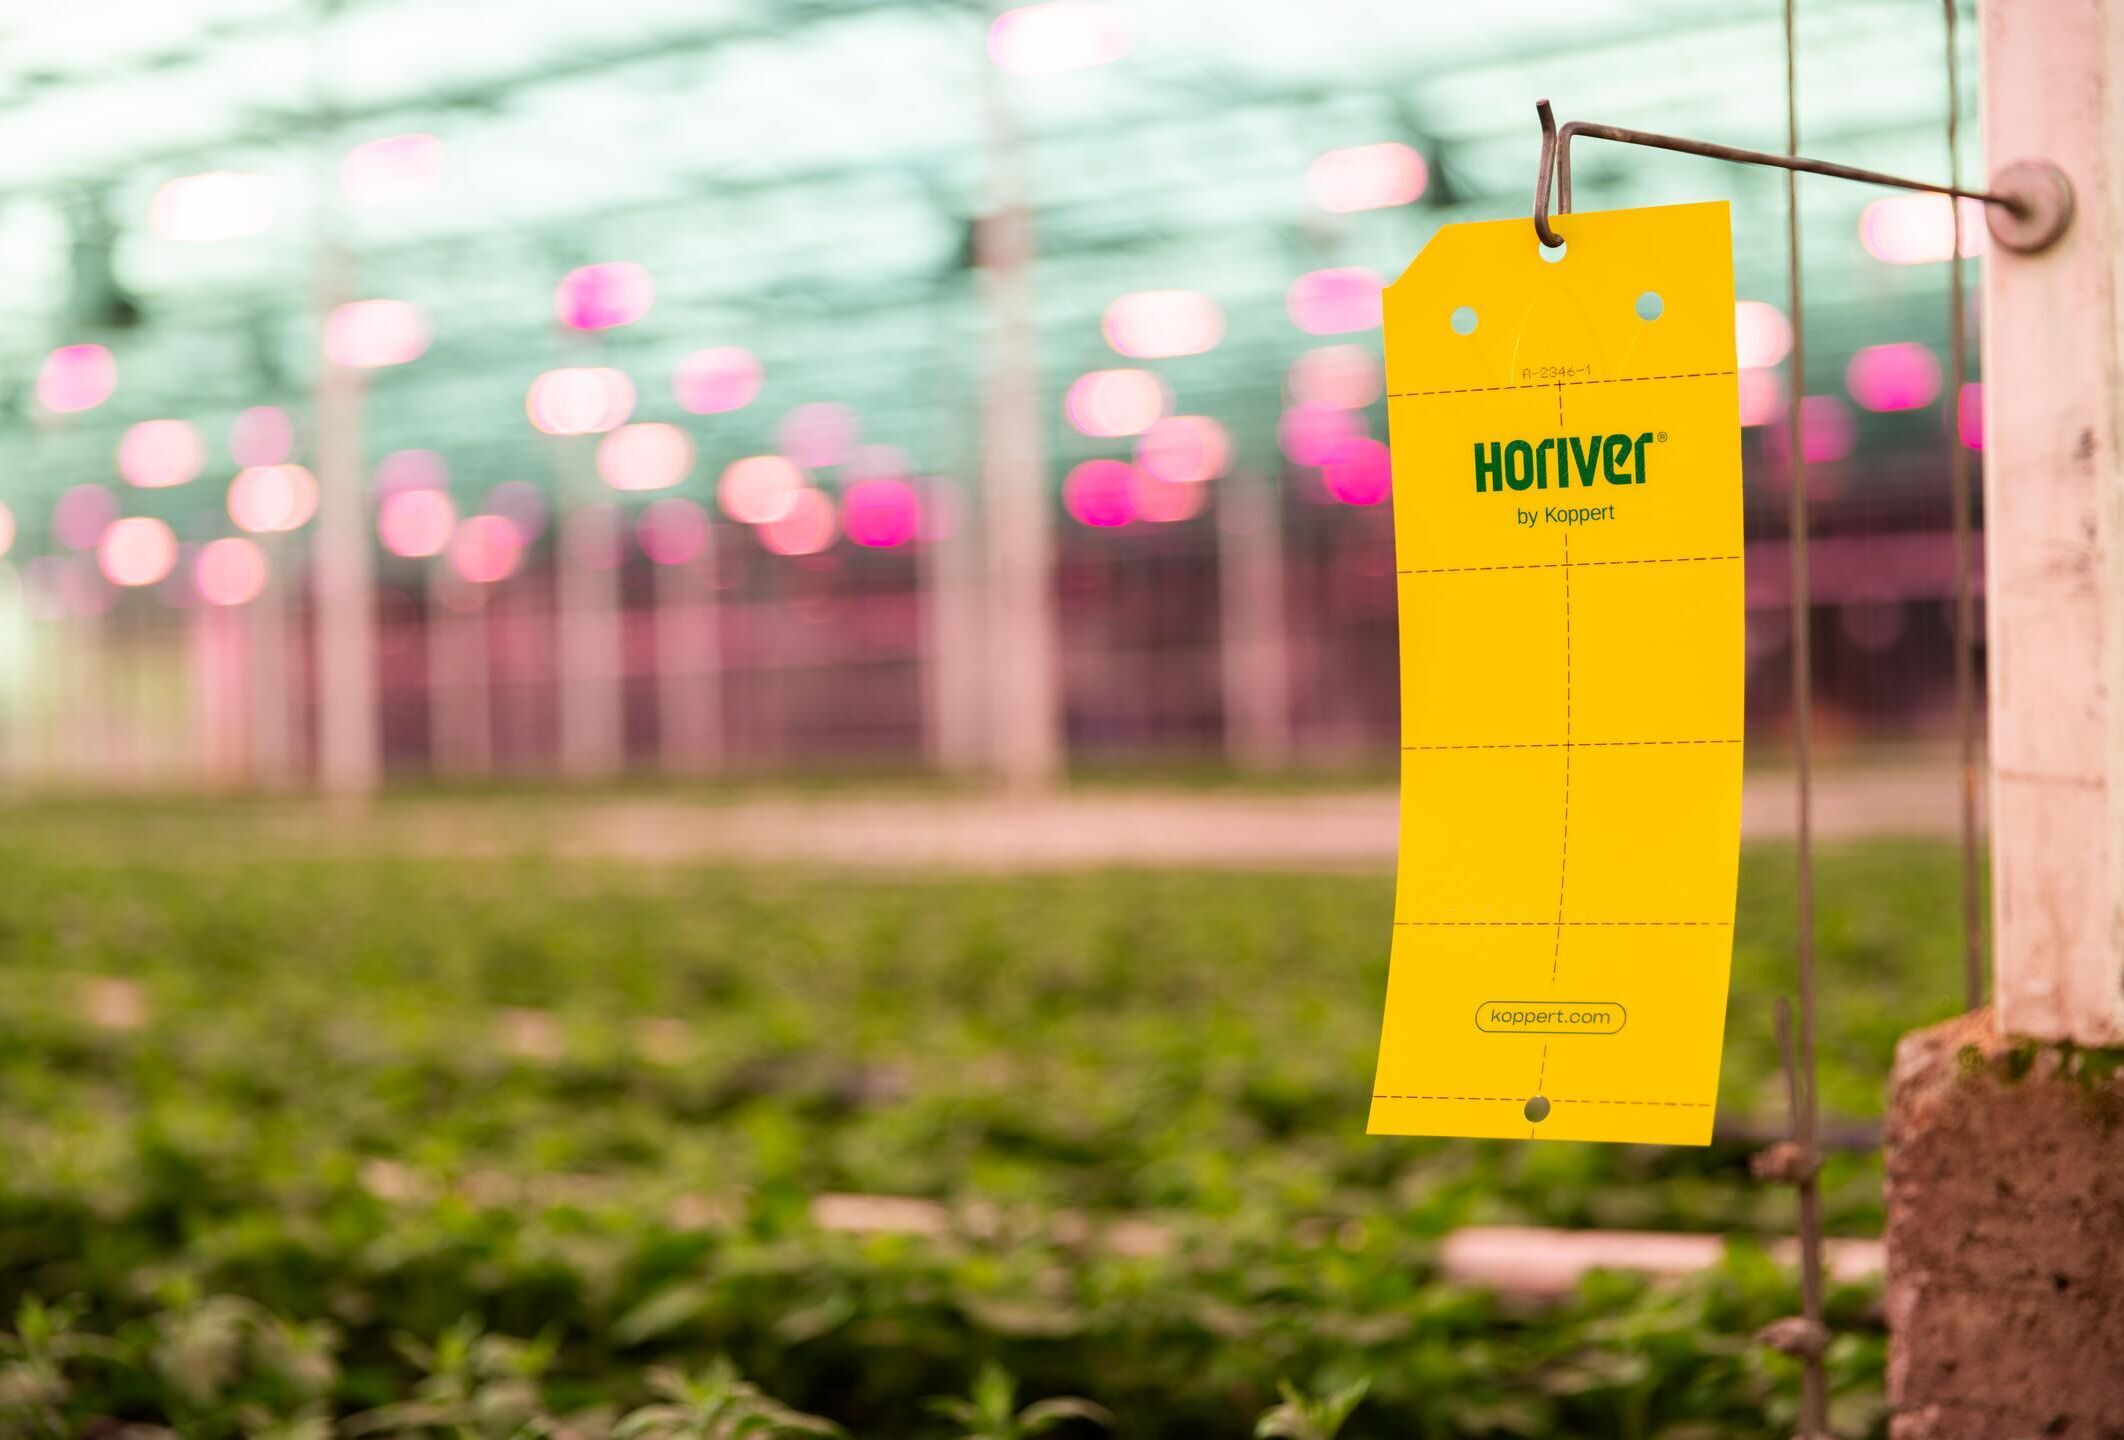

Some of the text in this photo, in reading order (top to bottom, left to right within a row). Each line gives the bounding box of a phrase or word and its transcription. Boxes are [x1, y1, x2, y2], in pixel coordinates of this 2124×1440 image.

[1518, 504, 1615, 528] by Koppert
[1491, 1008, 1611, 1026] koppert.com
